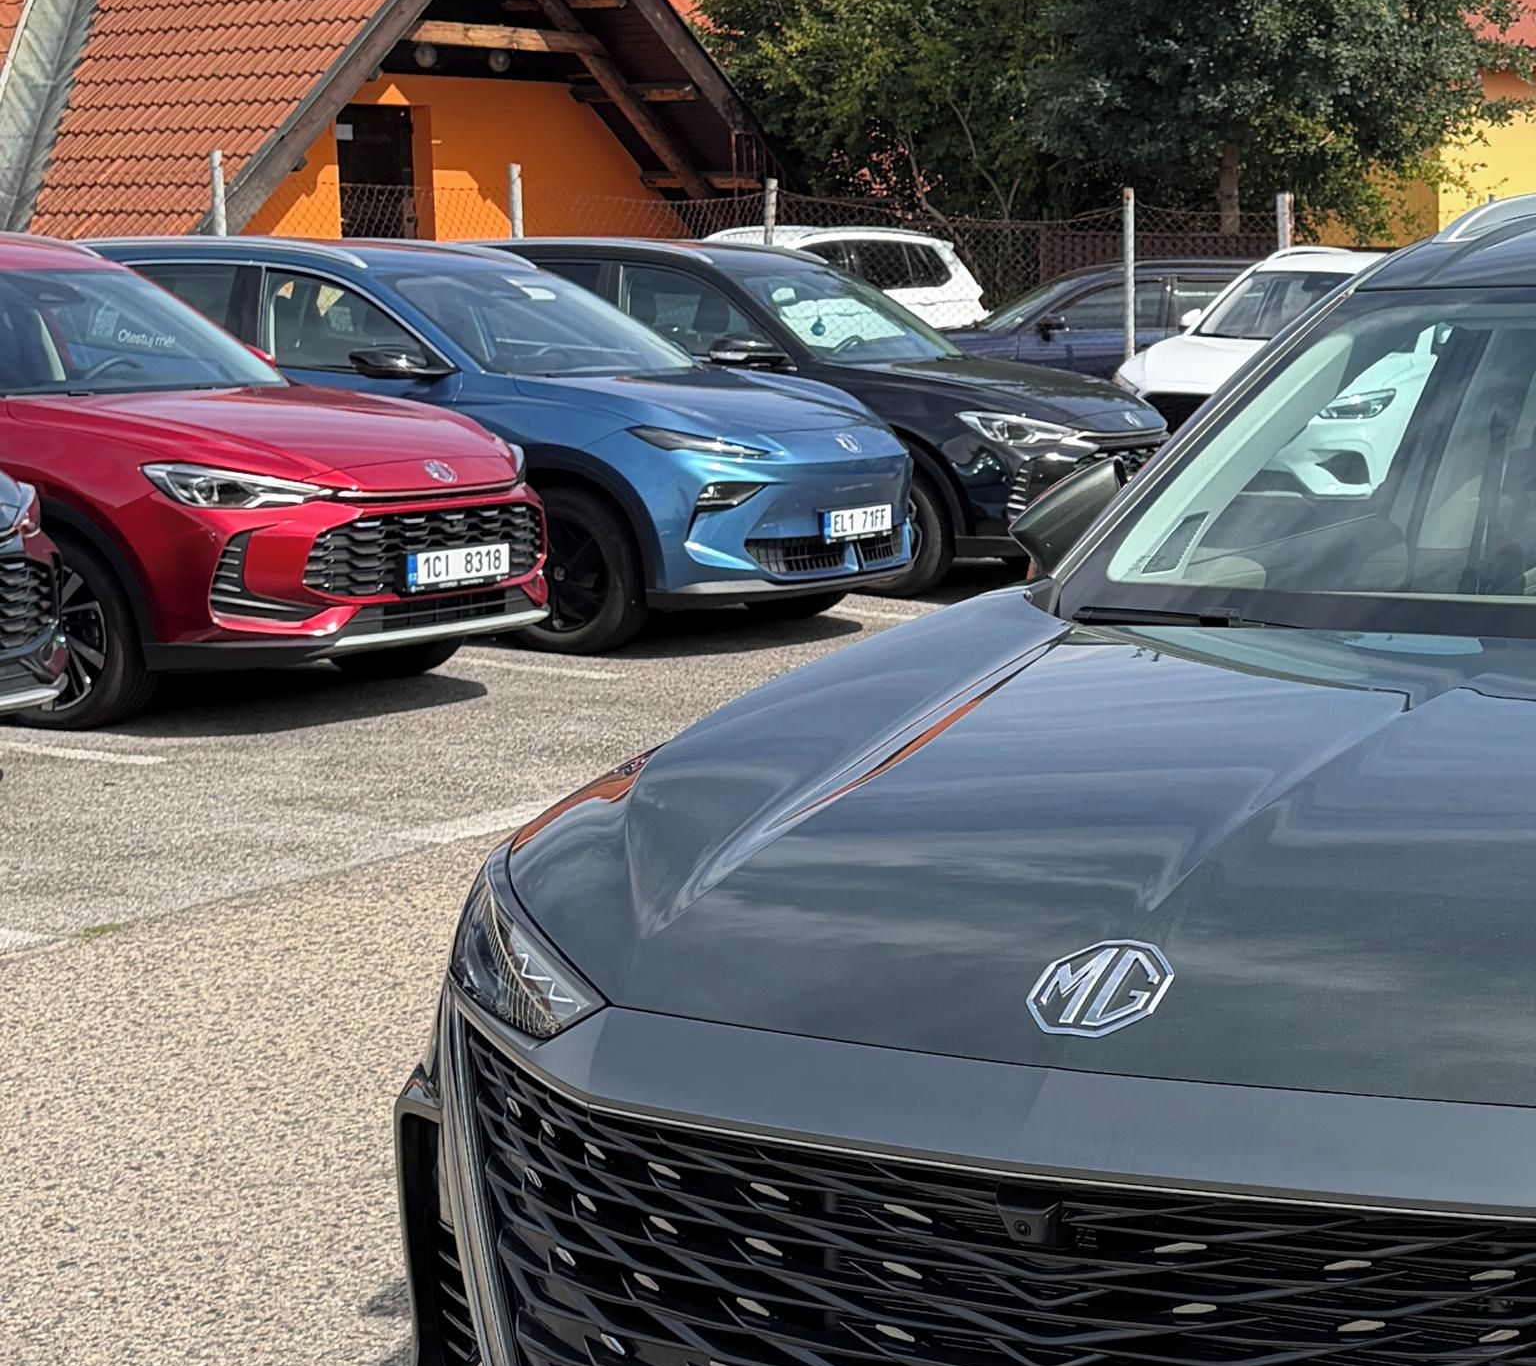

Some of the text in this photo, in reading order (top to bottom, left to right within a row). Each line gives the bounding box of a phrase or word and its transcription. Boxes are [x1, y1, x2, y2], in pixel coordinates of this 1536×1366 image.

[834, 513, 854, 533] EL1
[464, 548, 502, 574] 8318
[1038, 946, 1162, 1028] MG
